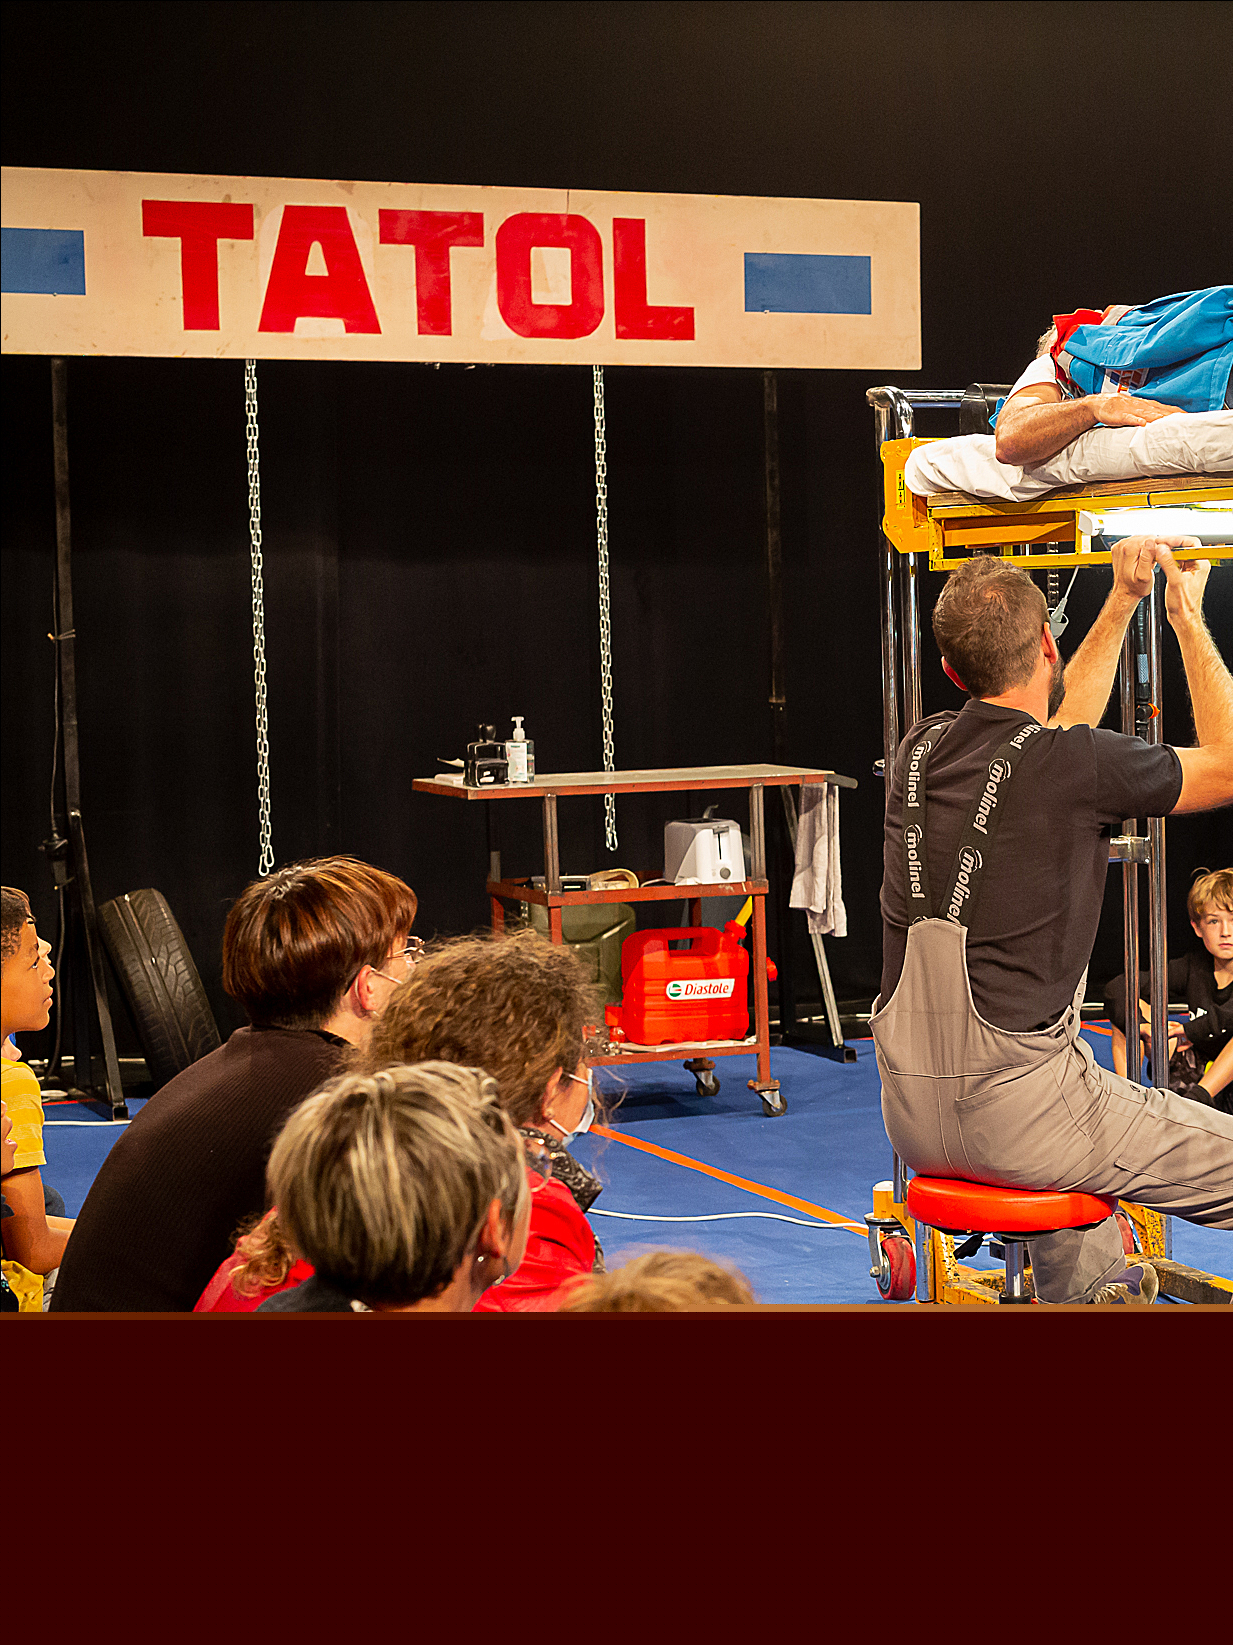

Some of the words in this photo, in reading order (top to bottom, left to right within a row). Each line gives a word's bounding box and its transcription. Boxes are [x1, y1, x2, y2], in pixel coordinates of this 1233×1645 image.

[141, 199, 696, 341] TATOL
[907, 744, 926, 807] molinel
[973, 761, 1005, 834] molinel
[907, 831, 926, 898] molinel
[946, 850, 975, 928] molinel
[684, 983, 729, 996] Diastole
